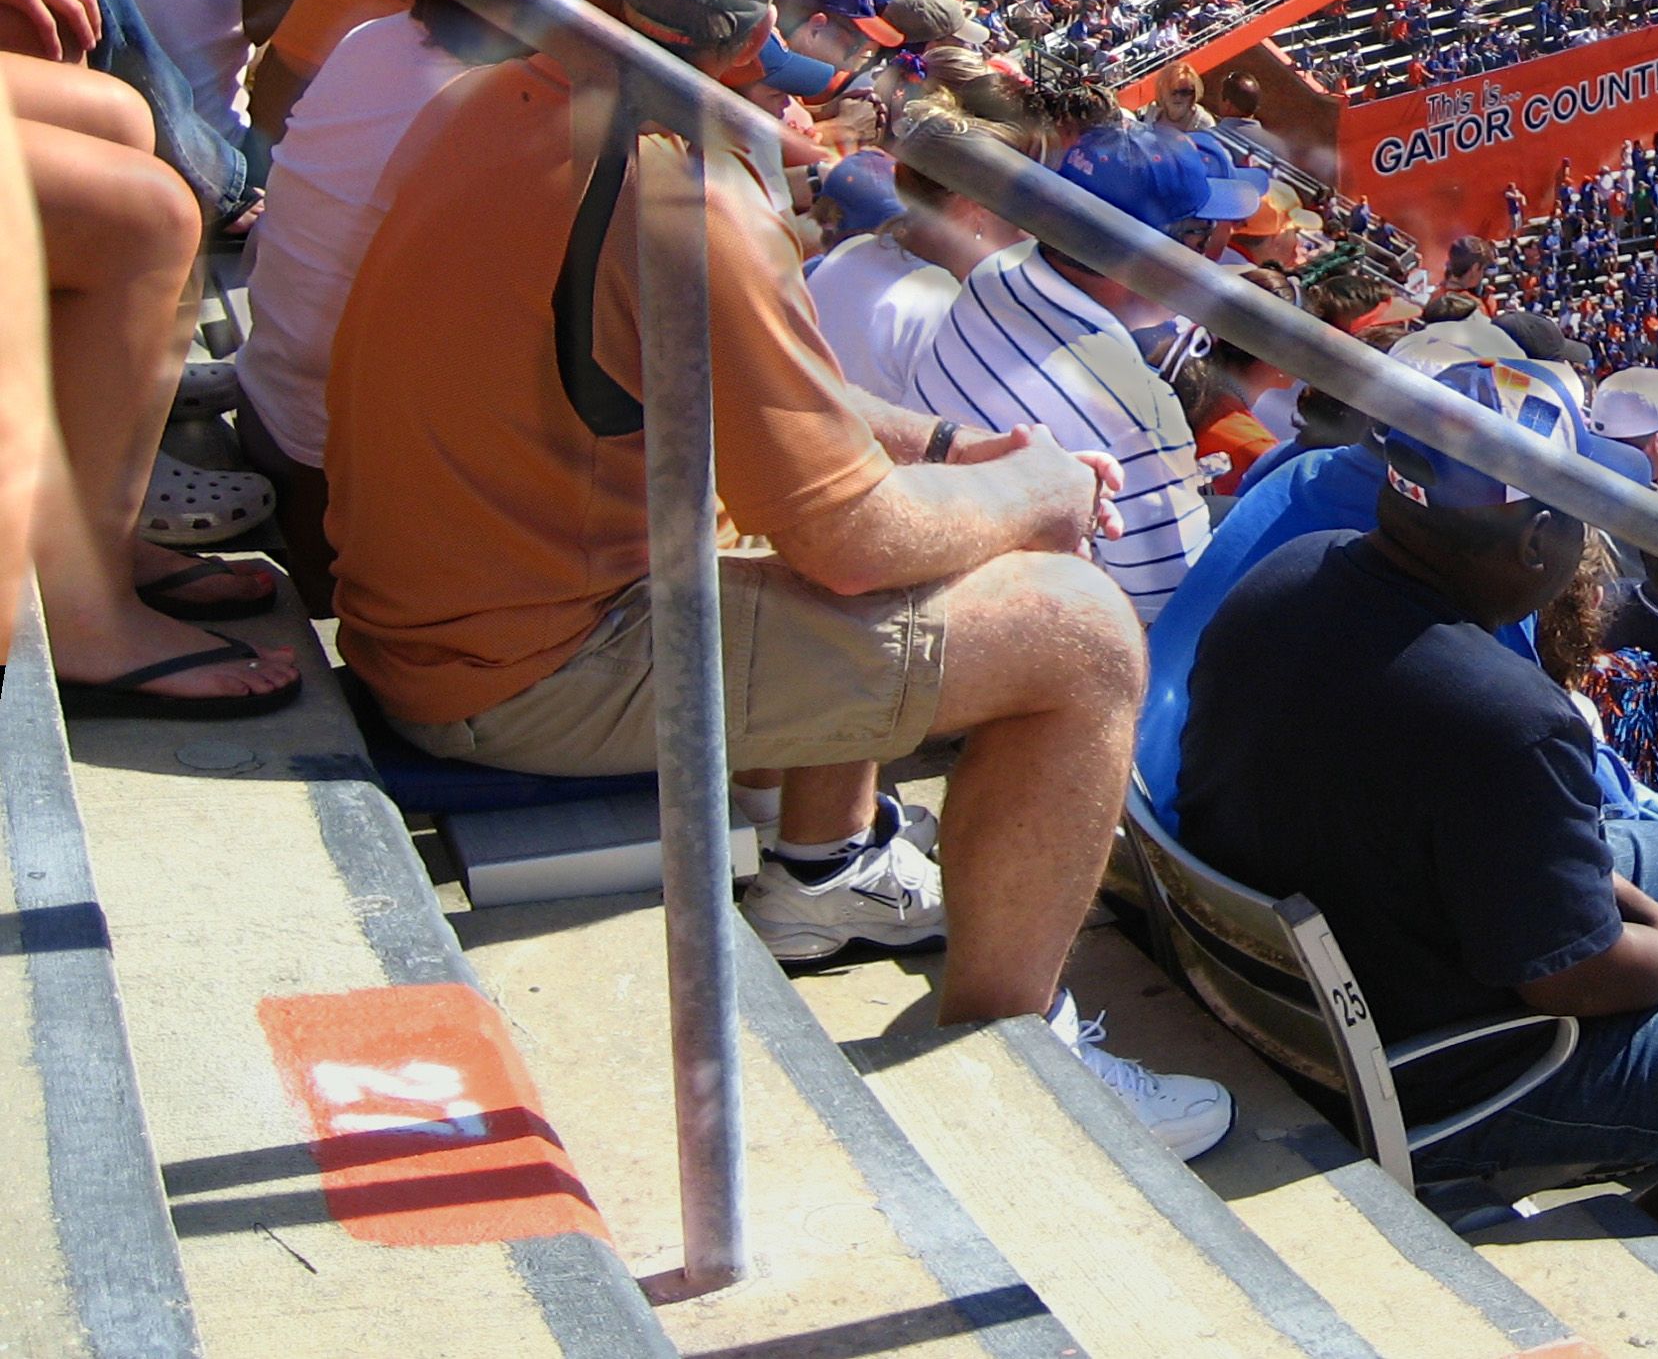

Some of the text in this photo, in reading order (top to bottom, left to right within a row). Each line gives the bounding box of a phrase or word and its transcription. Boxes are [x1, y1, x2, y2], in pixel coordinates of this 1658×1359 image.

[1426, 87, 1474, 124] This
[1372, 105, 1514, 174] GATOR
[1333, 981, 1367, 1027] 25
